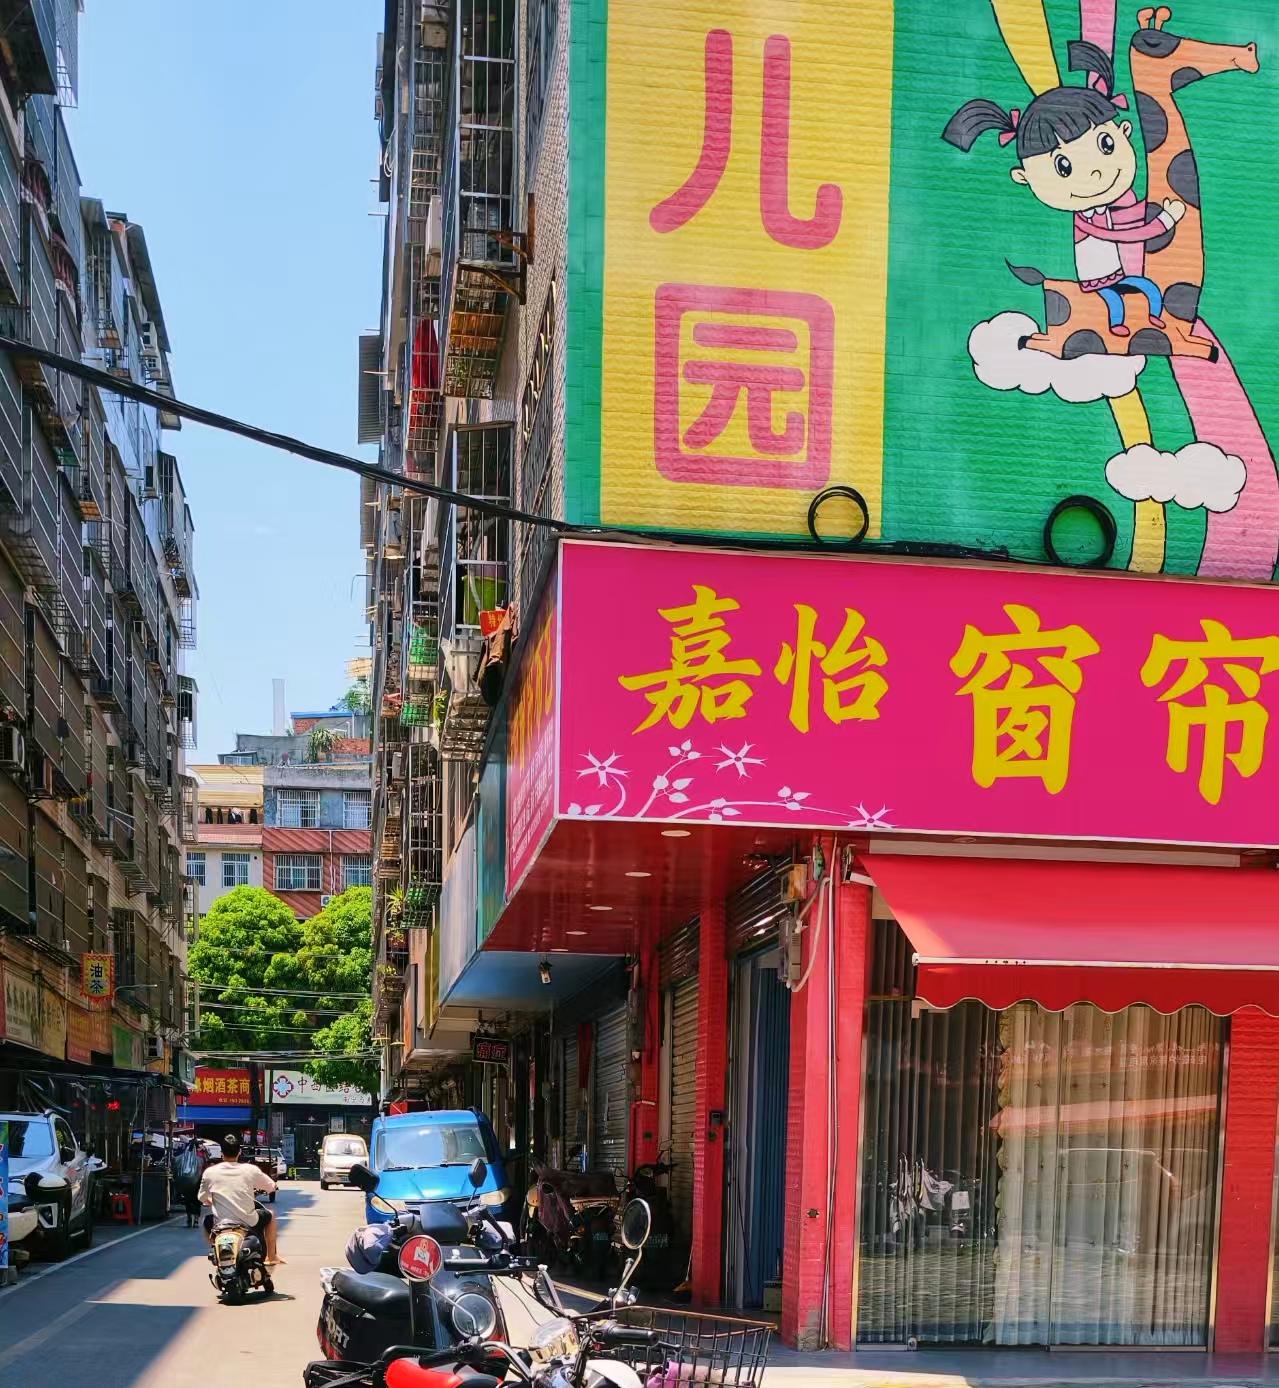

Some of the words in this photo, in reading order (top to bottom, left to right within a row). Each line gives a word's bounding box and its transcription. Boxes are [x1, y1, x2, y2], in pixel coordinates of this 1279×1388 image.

[649, 28, 843, 490] 儿园
[90, 963, 104, 994] 油茶
[195, 1077, 262, 1095] 烟酒茶商
